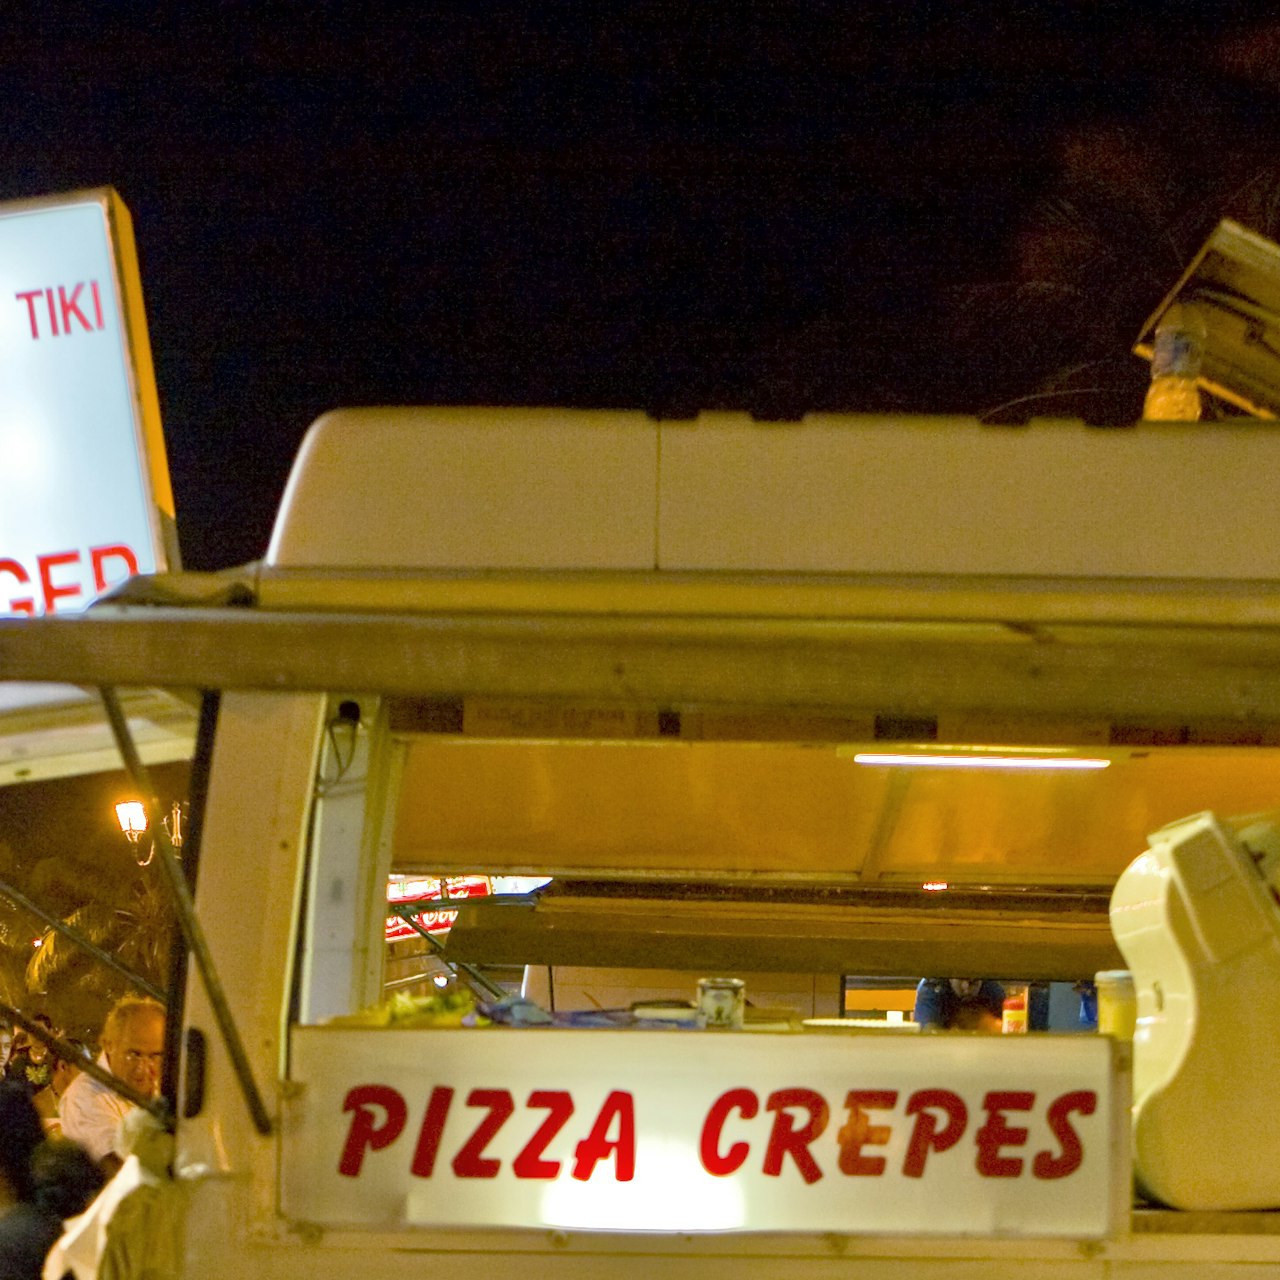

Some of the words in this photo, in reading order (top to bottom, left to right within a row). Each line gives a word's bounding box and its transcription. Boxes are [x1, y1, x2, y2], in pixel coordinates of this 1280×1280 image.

[15, 279, 106, 341] TIKI
[337, 1084, 637, 1182] PIZZA
[698, 1086, 1098, 1185] CREPES
